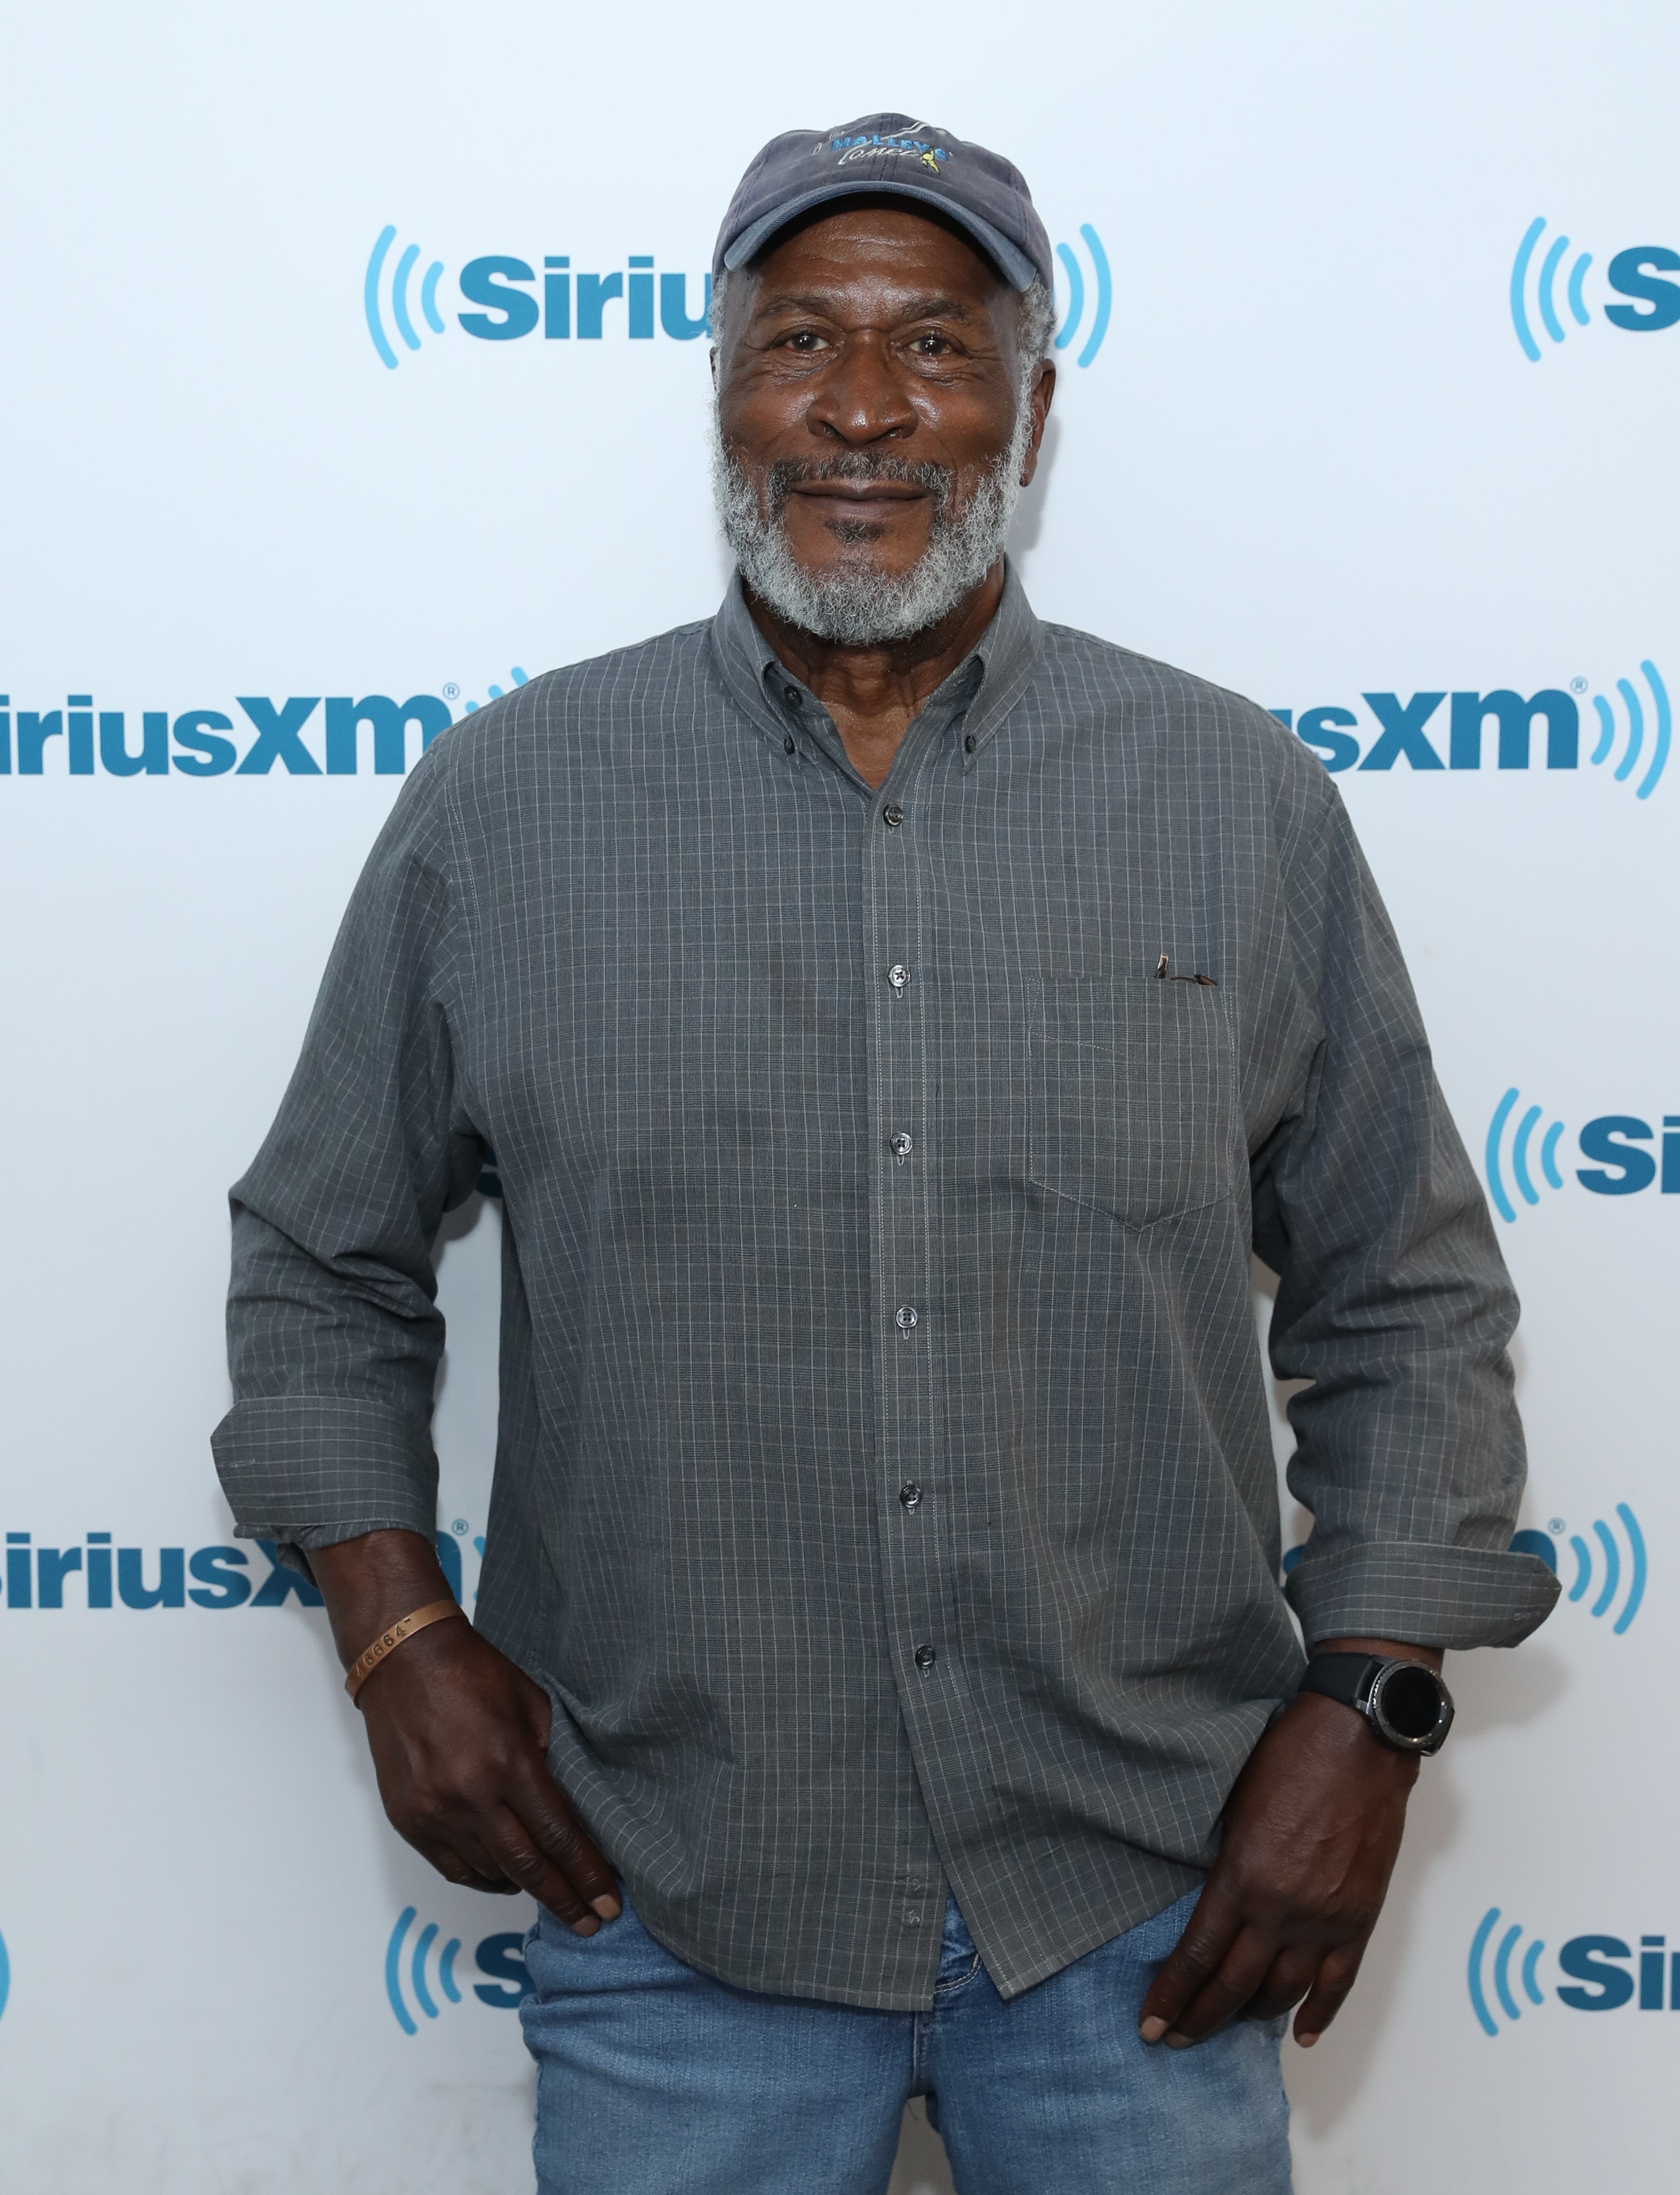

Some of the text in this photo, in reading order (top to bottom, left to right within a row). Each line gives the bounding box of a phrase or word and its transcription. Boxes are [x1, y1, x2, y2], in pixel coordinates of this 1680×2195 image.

[458, 255, 714, 340] Siriu
[473, 1932, 537, 2009] S
[1556, 1935, 1680, 2011] Si
